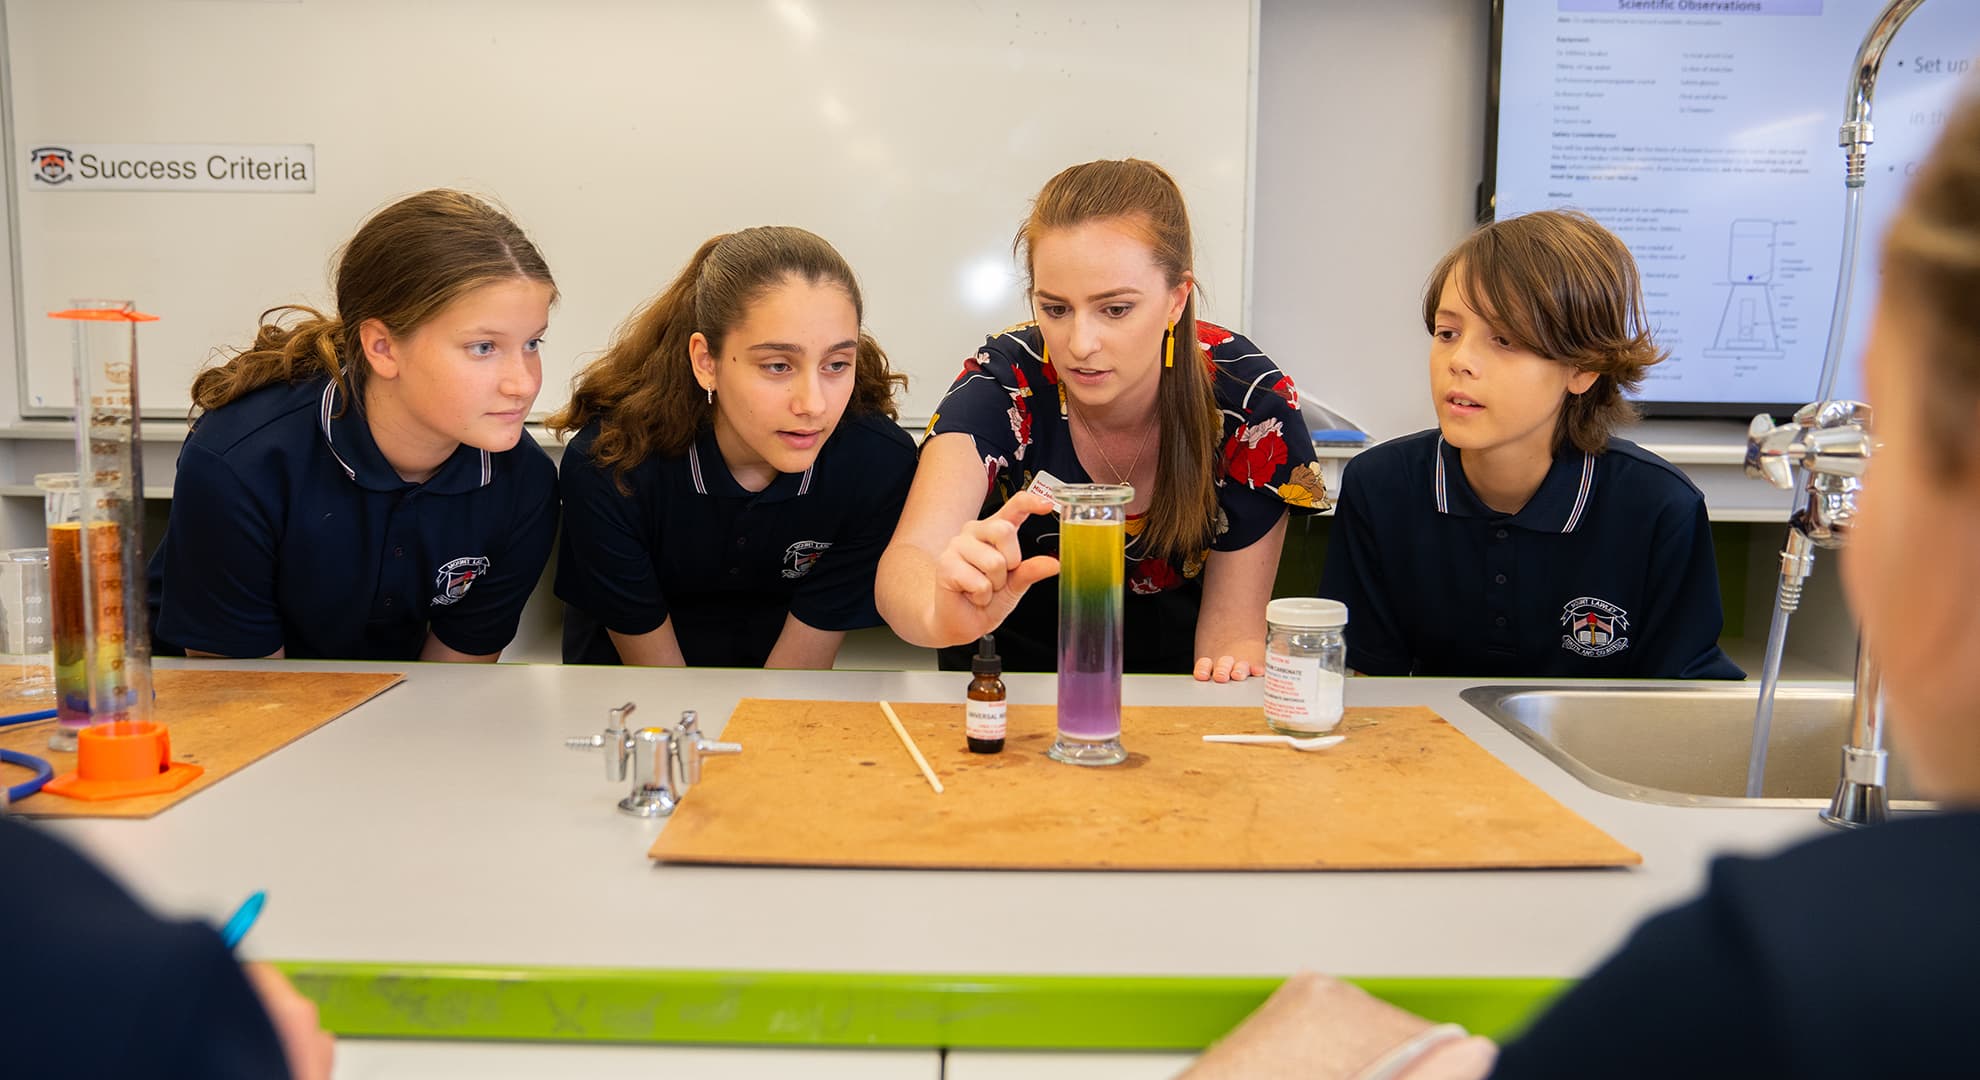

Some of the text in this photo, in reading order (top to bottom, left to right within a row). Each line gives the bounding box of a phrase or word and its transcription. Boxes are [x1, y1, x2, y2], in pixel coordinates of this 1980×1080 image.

[1618, 0, 1761, 12] Scientific Observations
[1914, 56, 1969, 77] Set up
[80, 153, 308, 182] Success Criteria
[25, 616, 43, 624] 400
